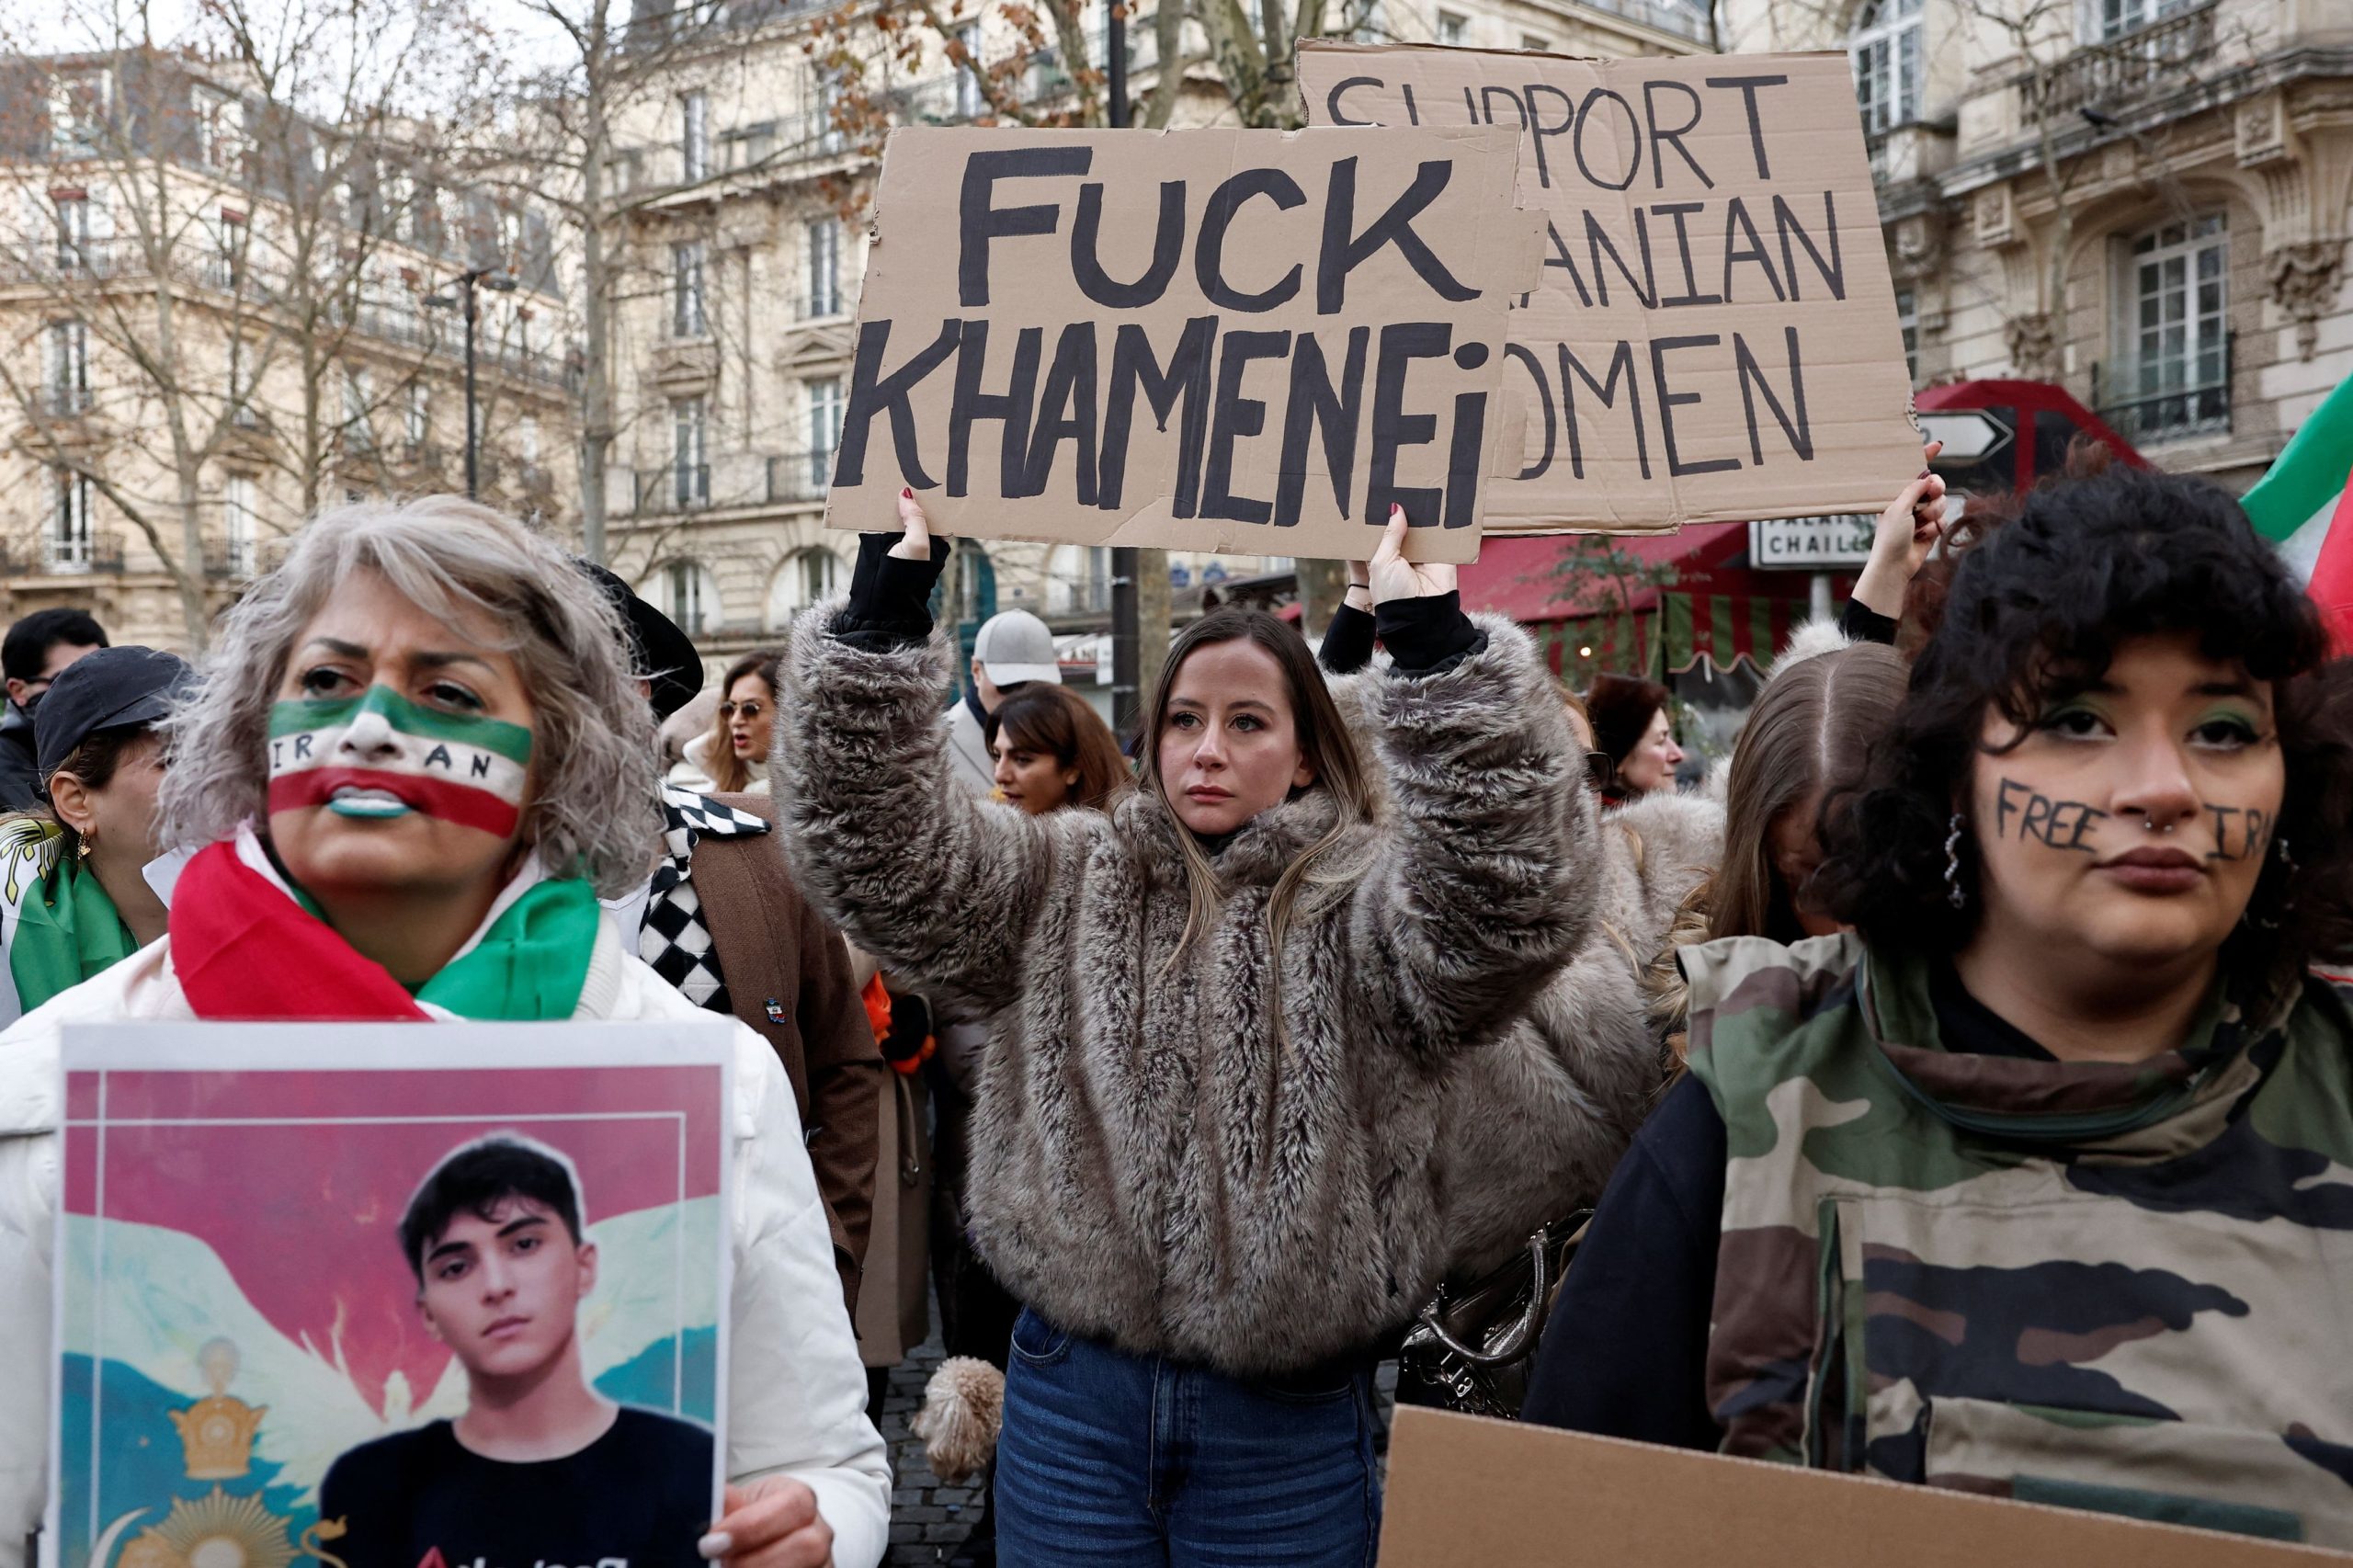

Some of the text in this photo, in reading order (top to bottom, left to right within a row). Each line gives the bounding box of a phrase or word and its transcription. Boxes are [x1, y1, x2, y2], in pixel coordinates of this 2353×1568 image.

[959, 145, 1483, 314] FUCK
[1508, 189, 1847, 311] ANIAN
[1503, 325, 1814, 481] OMEN
[272, 734, 492, 779] IRAN
[1995, 777, 2109, 855] FREE
